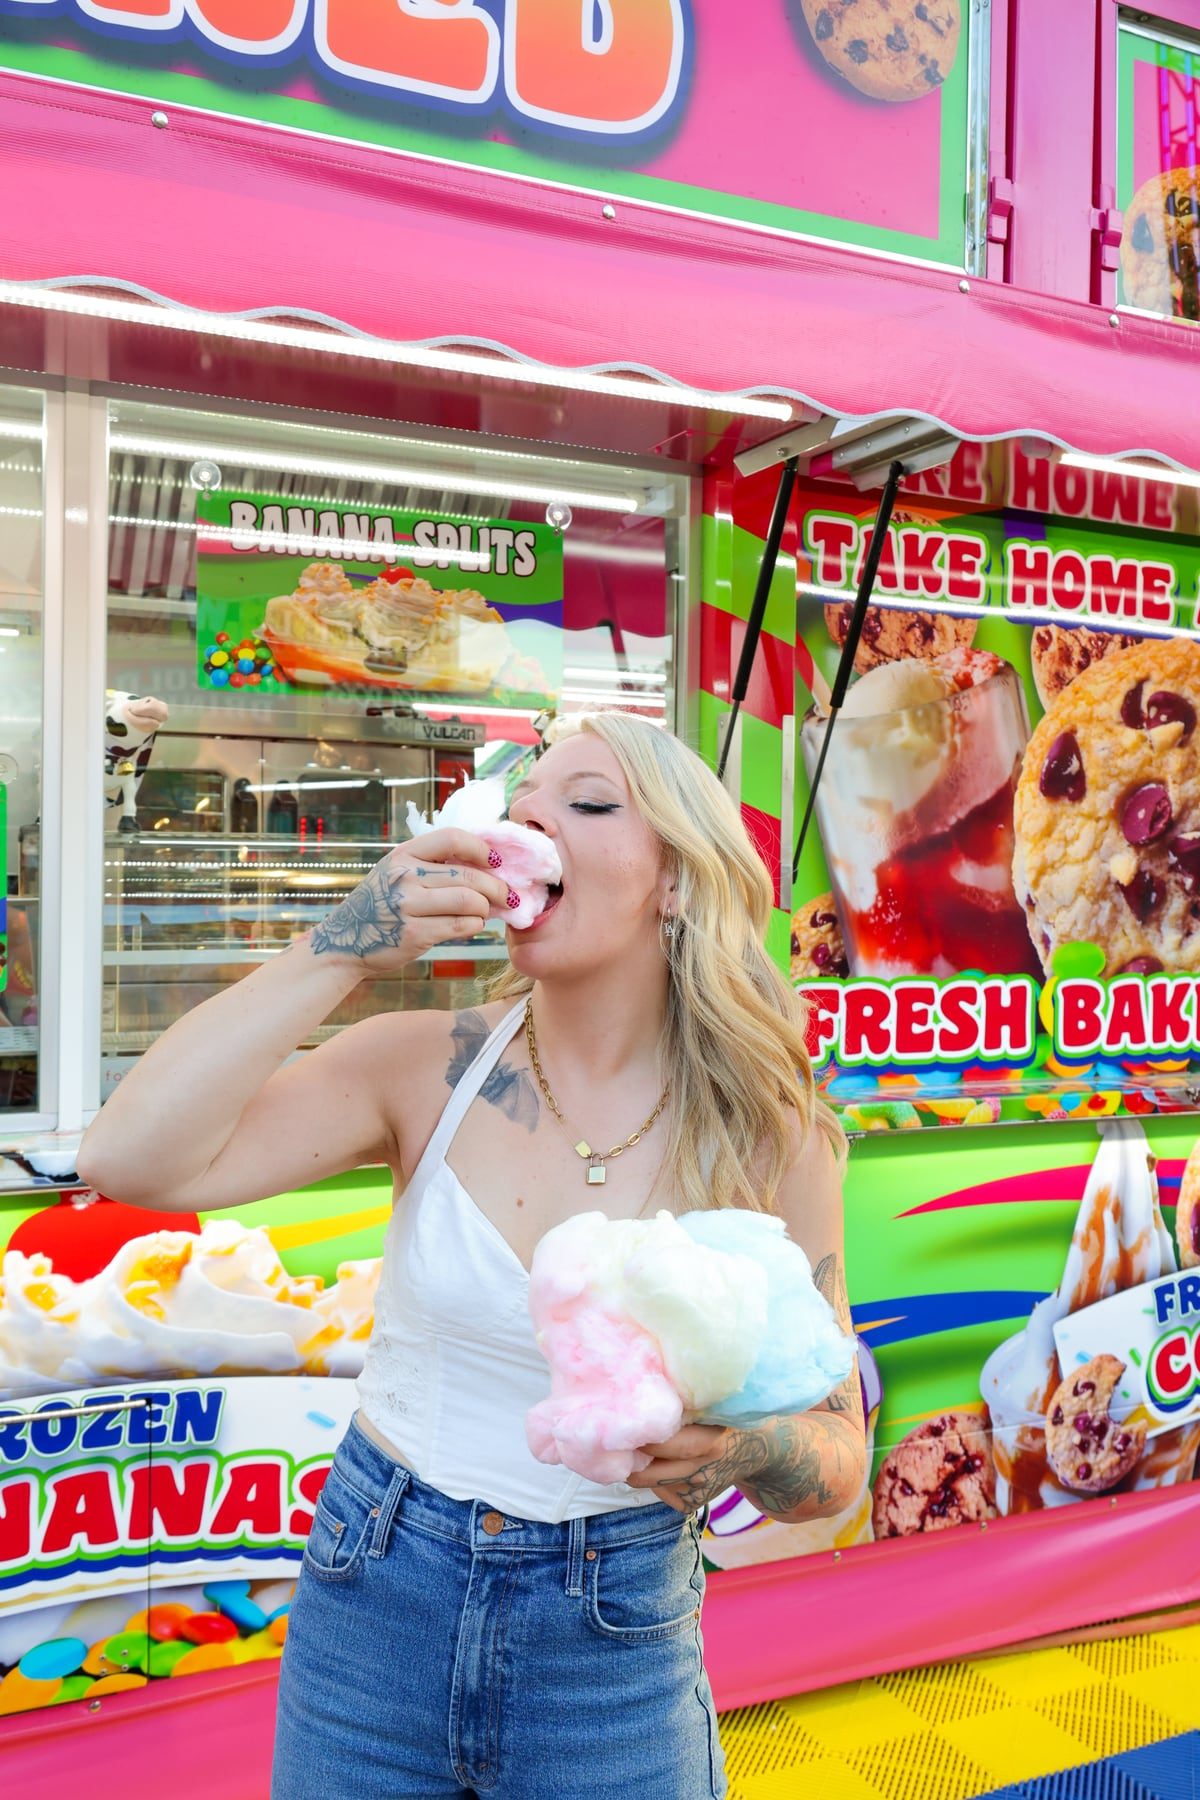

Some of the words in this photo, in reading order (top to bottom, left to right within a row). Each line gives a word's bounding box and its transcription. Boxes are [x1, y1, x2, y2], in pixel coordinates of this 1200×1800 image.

[229, 501, 397, 564] BANANA
[413, 520, 537, 577] SPLITS
[810, 519, 984, 601] TAKE
[1009, 542, 1174, 623] HOME
[798, 983, 1028, 1058] FRESH
[1061, 982, 1200, 1048] BAK
